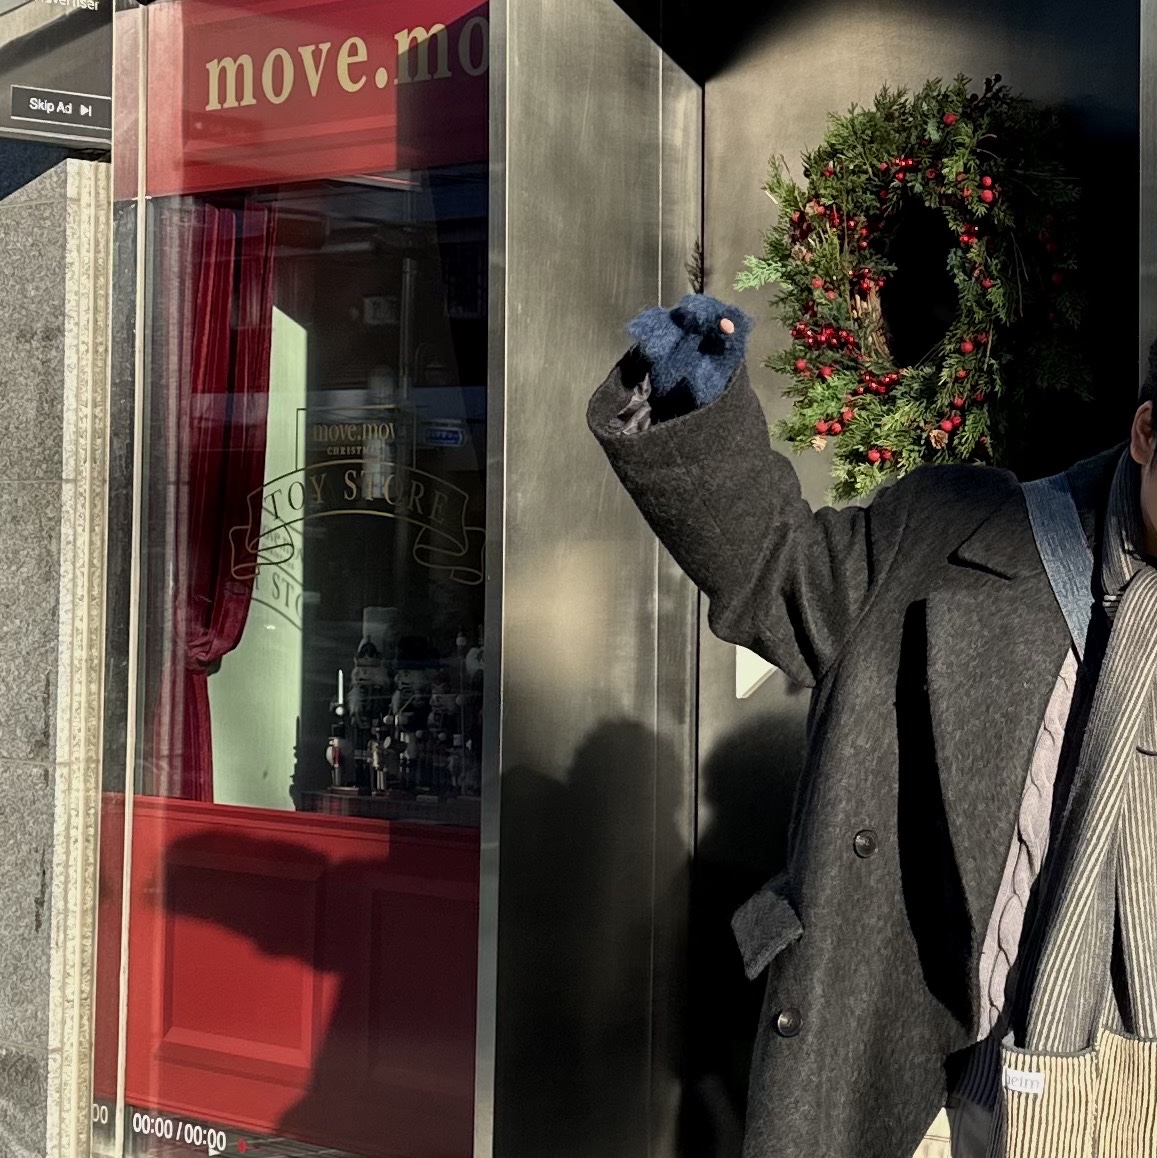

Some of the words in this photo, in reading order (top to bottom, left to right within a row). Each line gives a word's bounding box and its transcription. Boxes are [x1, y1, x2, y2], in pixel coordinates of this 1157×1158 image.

[29, 97, 55, 114] Skip
[56, 101, 73, 114] Ad
[264, 472, 327, 521] TOY
[343, 469, 448, 525] STORE
[132, 1112, 173, 1139] 00:00
[175, 1121, 183, 1141] /
[184, 1123, 227, 1151] 00:00
